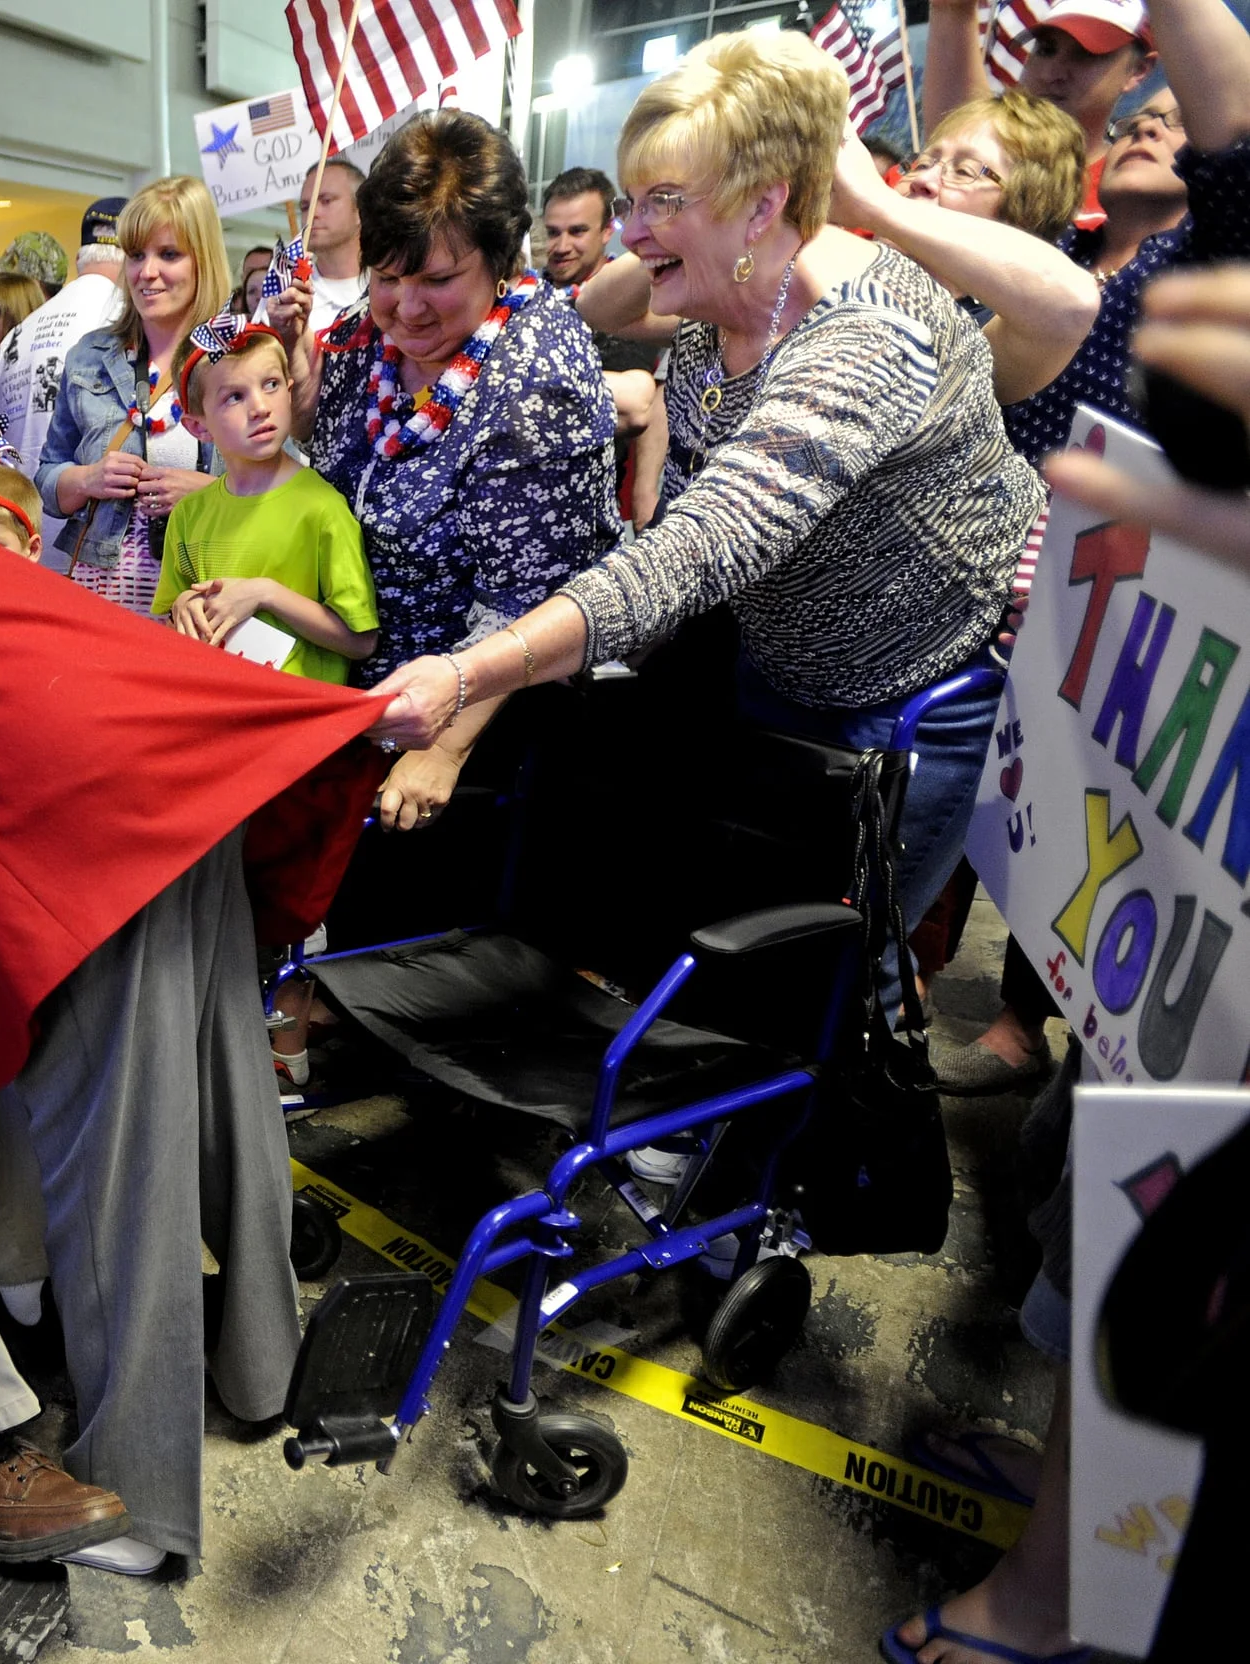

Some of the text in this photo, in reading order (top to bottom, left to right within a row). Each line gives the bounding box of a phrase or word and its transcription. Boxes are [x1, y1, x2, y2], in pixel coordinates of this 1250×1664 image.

[254, 132, 302, 165] GOD
[1058, 519, 1250, 890] THAN
[996, 719, 1024, 760] WE
[1006, 802, 1036, 853] U!
[1051, 787, 1233, 1082] YOU
[1046, 951, 1134, 1085] for bein
[381, 1236, 456, 1291] AUTION
[688, 1401, 742, 1428] HANSON
[843, 1451, 984, 1532] CAUTION
